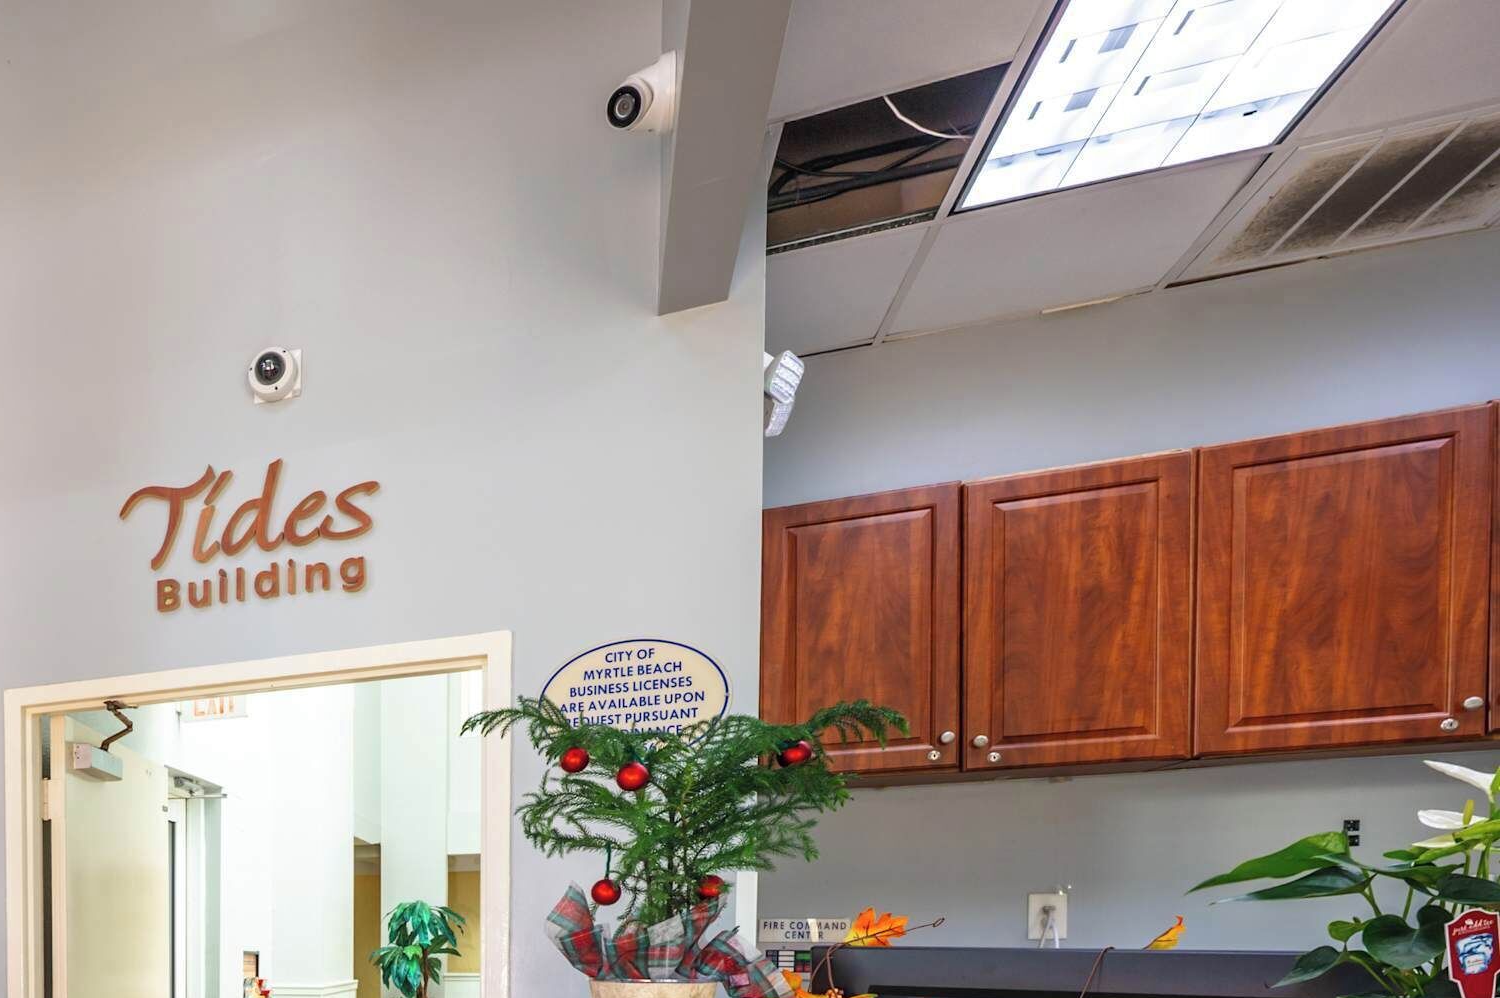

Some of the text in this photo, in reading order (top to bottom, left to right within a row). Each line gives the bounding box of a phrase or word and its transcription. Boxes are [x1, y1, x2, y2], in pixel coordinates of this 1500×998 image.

[119, 457, 380, 572] Tides
[156, 556, 366, 614] Building
[605, 648, 656, 664] CITY OF
[583, 661, 683, 681] MYRTLE BEACH
[569, 676, 693, 698] BUSINESS LICENSES
[560, 691, 706, 713] ARE AVAILABLE UPON
[625, 707, 699, 724] PURSUANT
[763, 922, 785, 930] FIRE
[784, 931, 824, 939] CENTR
